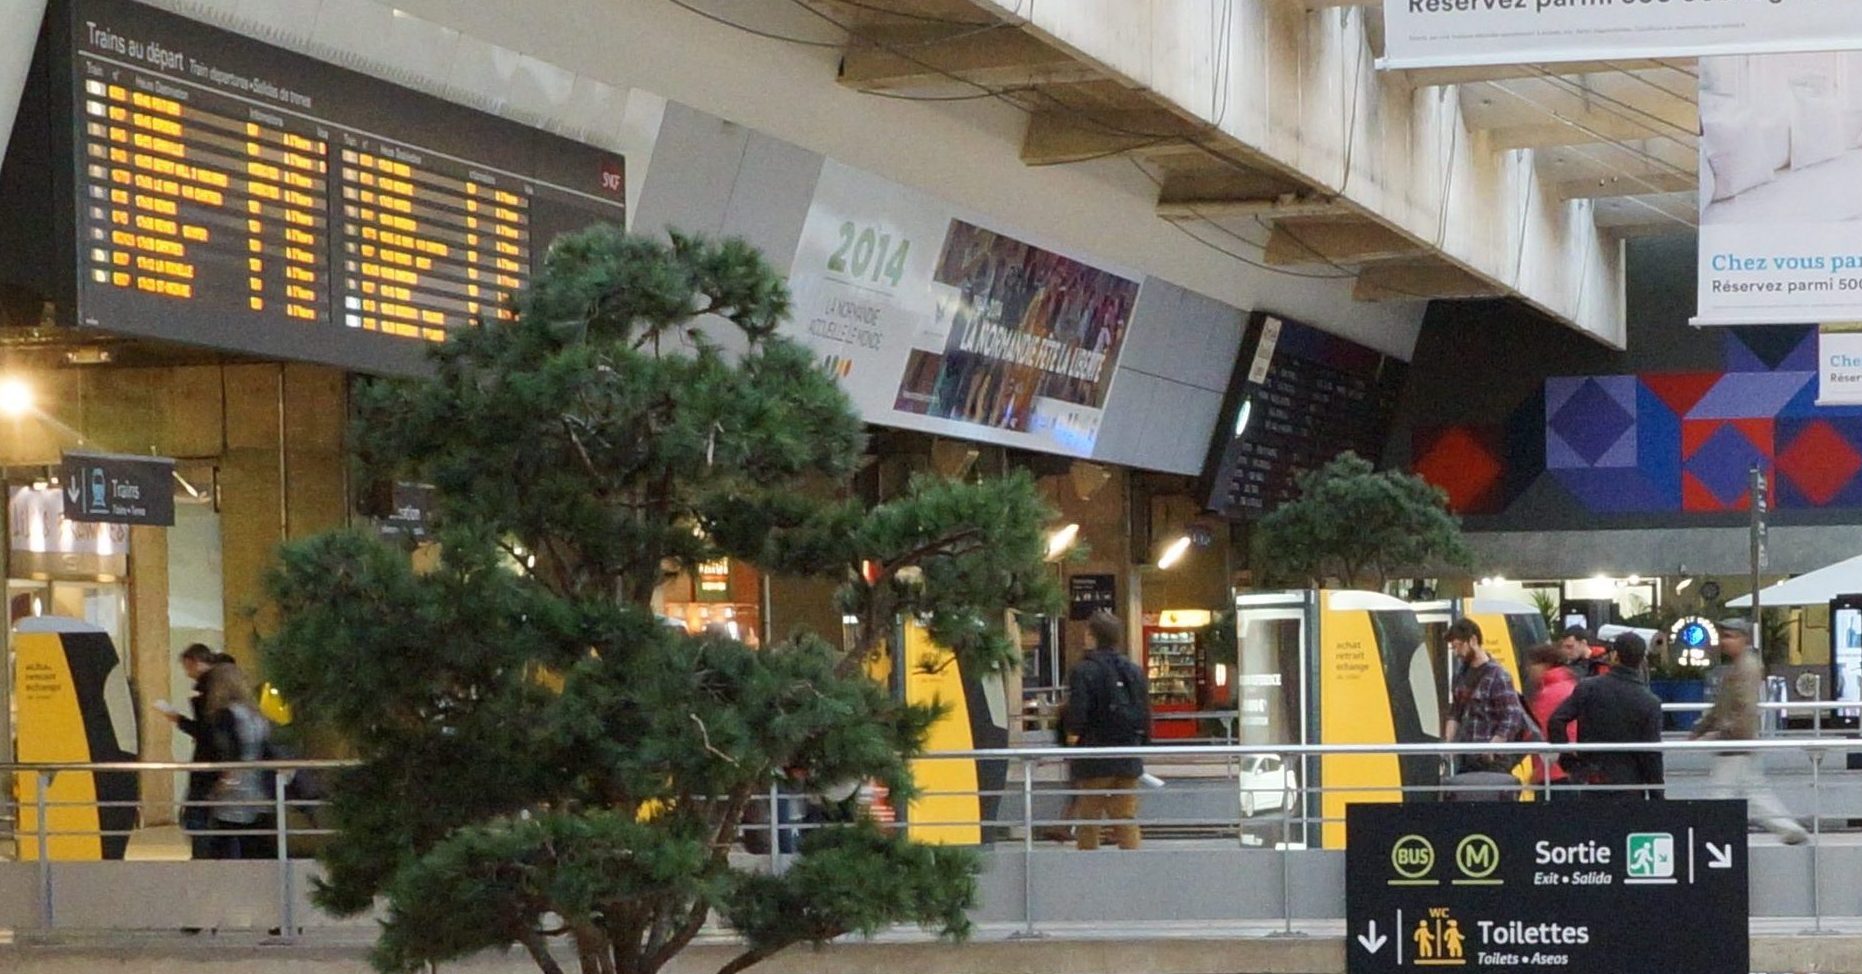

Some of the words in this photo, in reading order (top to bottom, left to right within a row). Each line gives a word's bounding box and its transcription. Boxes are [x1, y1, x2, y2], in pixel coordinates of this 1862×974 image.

[86, 21, 125, 54] Trains
[128, 40, 144, 59] au
[147, 42, 185, 71] départ
[827, 220, 911, 287] 2014
[1712, 254, 1767, 272] Chez
[1774, 257, 1824, 270] vous
[1712, 278, 1781, 293] Réservez
[1788, 277, 1833, 293] parmi
[112, 479, 140, 499] Trains
[1398, 847, 1429, 864] BUS
[1466, 845, 1489, 867] M
[1535, 840, 1612, 864] Sortie
[1534, 872, 1560, 886] Exit
[1571, 872, 1612, 886] Salida
[1429, 908, 1449, 917] WC
[1477, 920, 1589, 944] Toilettes
[1477, 952, 1519, 965] Toilets
[1531, 952, 1568, 965] Aseos
